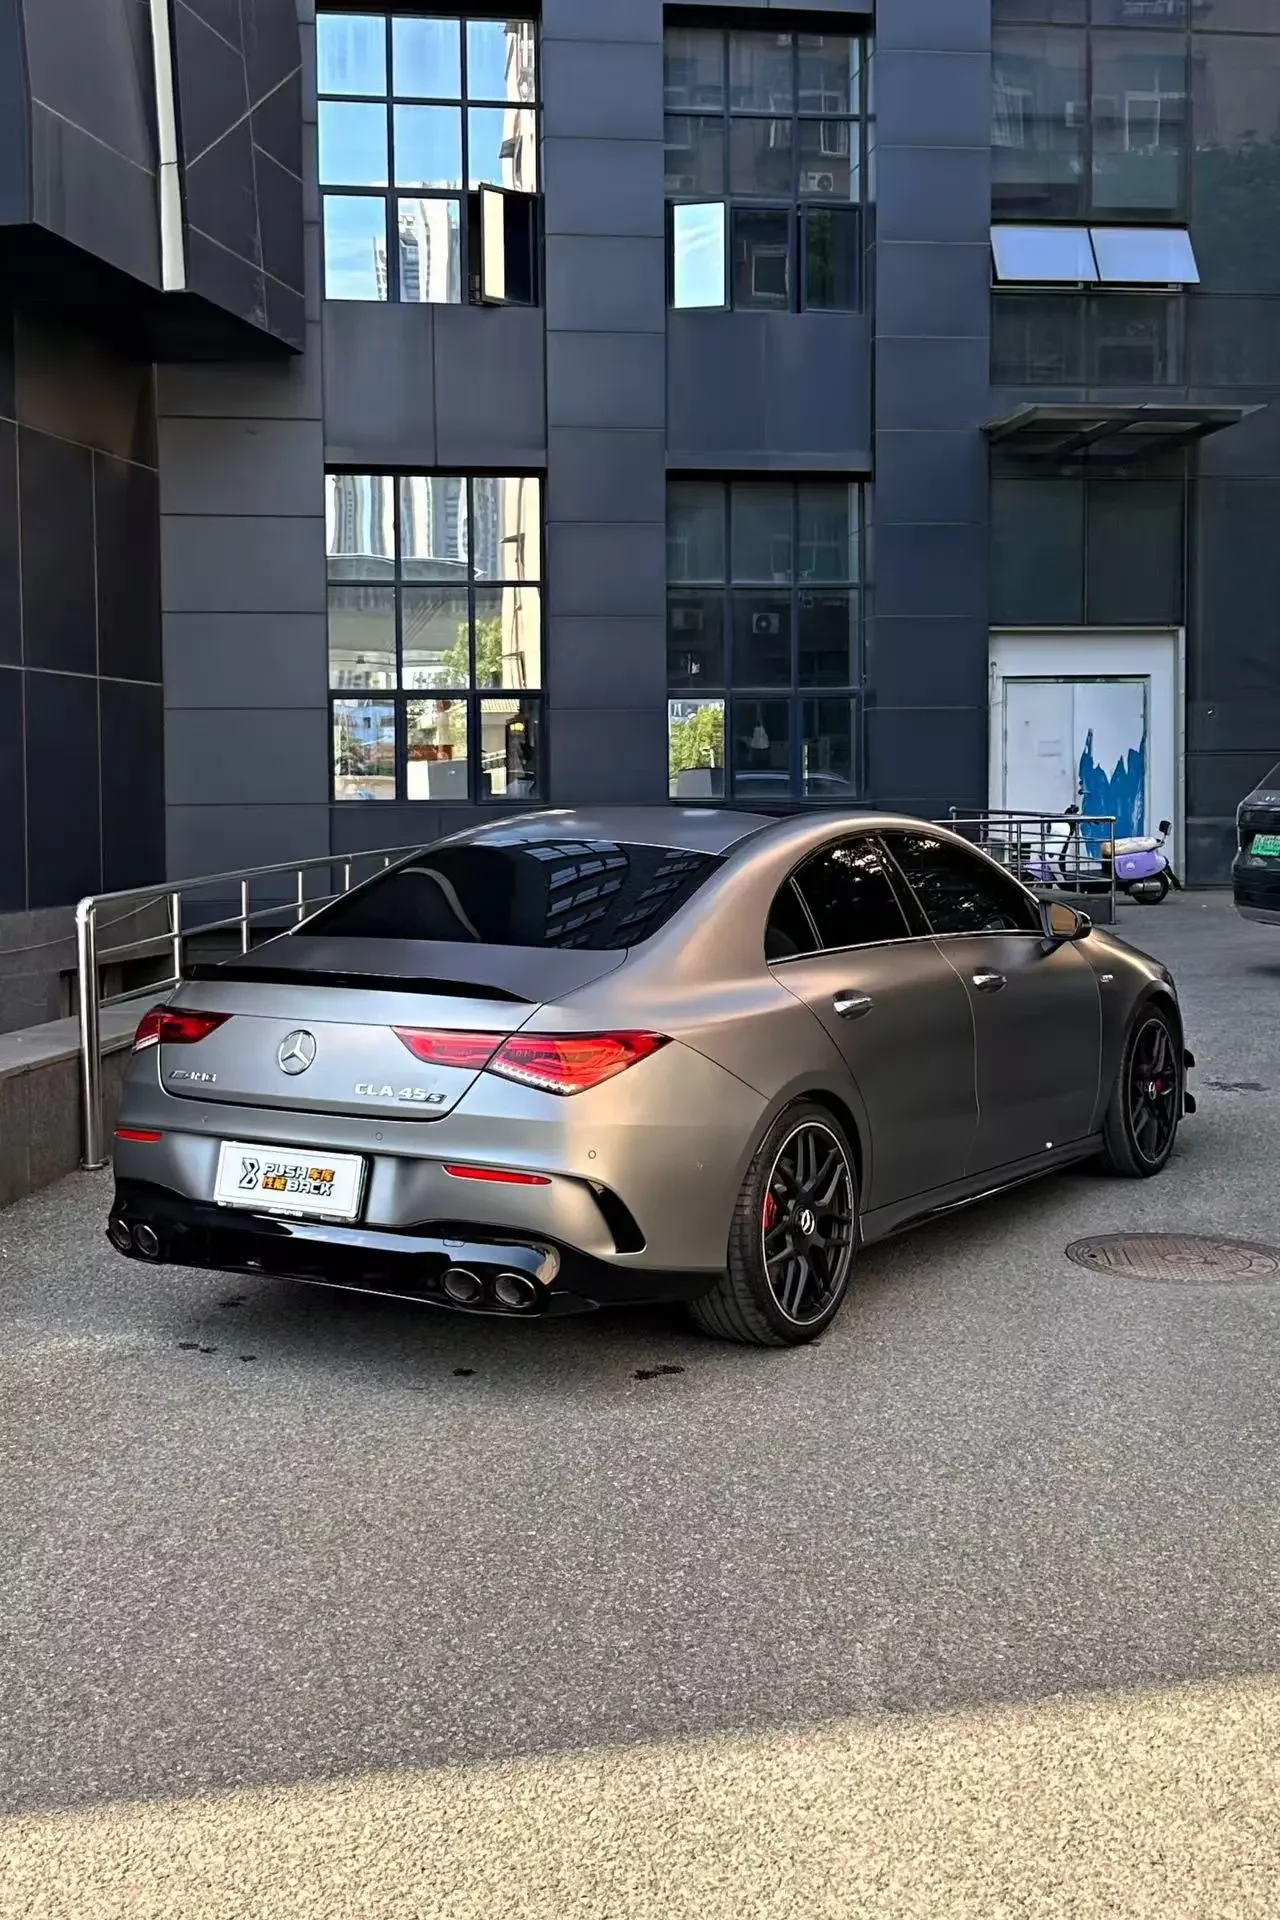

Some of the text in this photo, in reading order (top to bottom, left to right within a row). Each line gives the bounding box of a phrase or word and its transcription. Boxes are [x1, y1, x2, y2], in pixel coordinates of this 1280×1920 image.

[355, 1083, 393, 1097] CLA
[264, 1163, 309, 1180] PUSH
[287, 1179, 335, 1196] BACK
